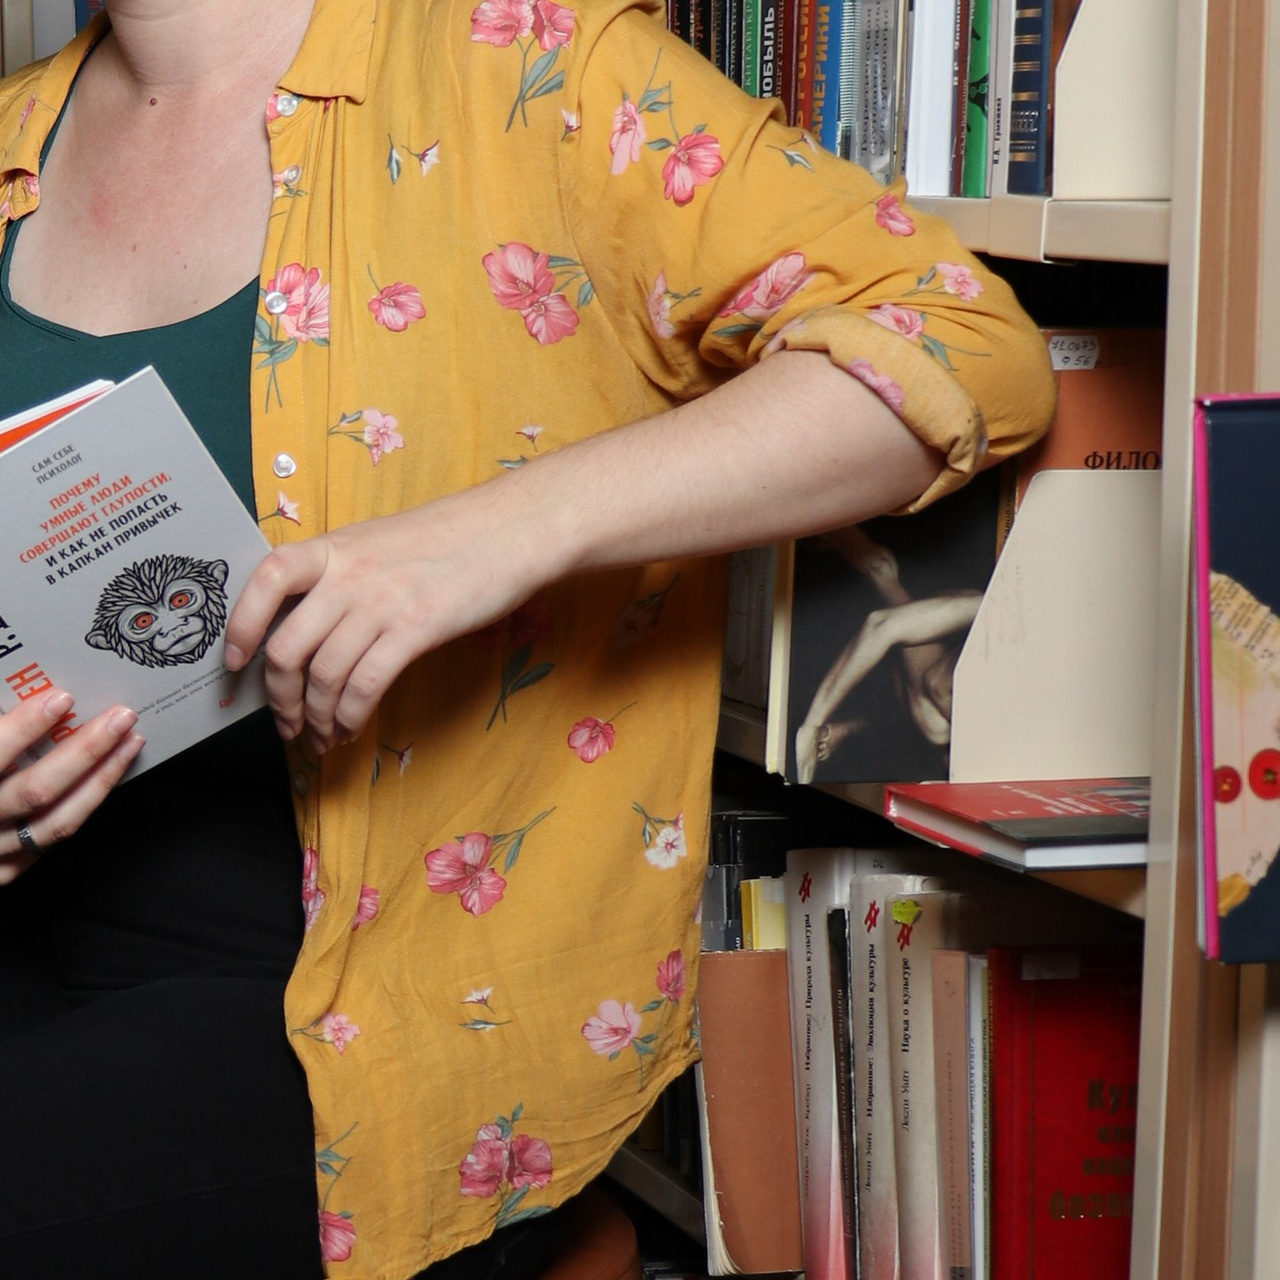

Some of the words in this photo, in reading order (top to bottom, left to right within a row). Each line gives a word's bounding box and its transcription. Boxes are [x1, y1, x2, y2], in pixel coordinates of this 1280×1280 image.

[810, 6, 830, 138] АМЕРИКИ
[32, 457, 51, 474] САМ
[54, 444, 76, 462] СЕБЕ
[37, 453, 83, 484] ПСИХОЛОГ
[19, 513, 98, 563] СОВЕРШАЮТ
[102, 472, 172, 521] ГЛУПОСТИ,
[40, 503, 86, 534] УМНЫЕ
[90, 475, 132, 505] ЛЮДИ
[49, 474, 102, 510] ПОЧЕМУ
[45, 556, 57, 568] И
[60, 540, 88, 560] КАК
[90, 526, 107, 542] НЕ
[109, 493, 168, 532] ПОПАСТЬ
[46, 574, 57, 585] В
[59, 545, 114, 579] КАПКАН
[116, 502, 183, 547] ПРИВЫЧЕК
[802, 914, 813, 962] культуры
[804, 965, 814, 1009] Природа
[867, 944, 876, 992] культуры
[901, 958, 910, 1004] культуре
[804, 1013, 813, 1070] Избранное:
[866, 997, 875, 1052] Эволюция
[901, 1019, 911, 1053] Наука
[866, 1056, 875, 1118] Избранное:
